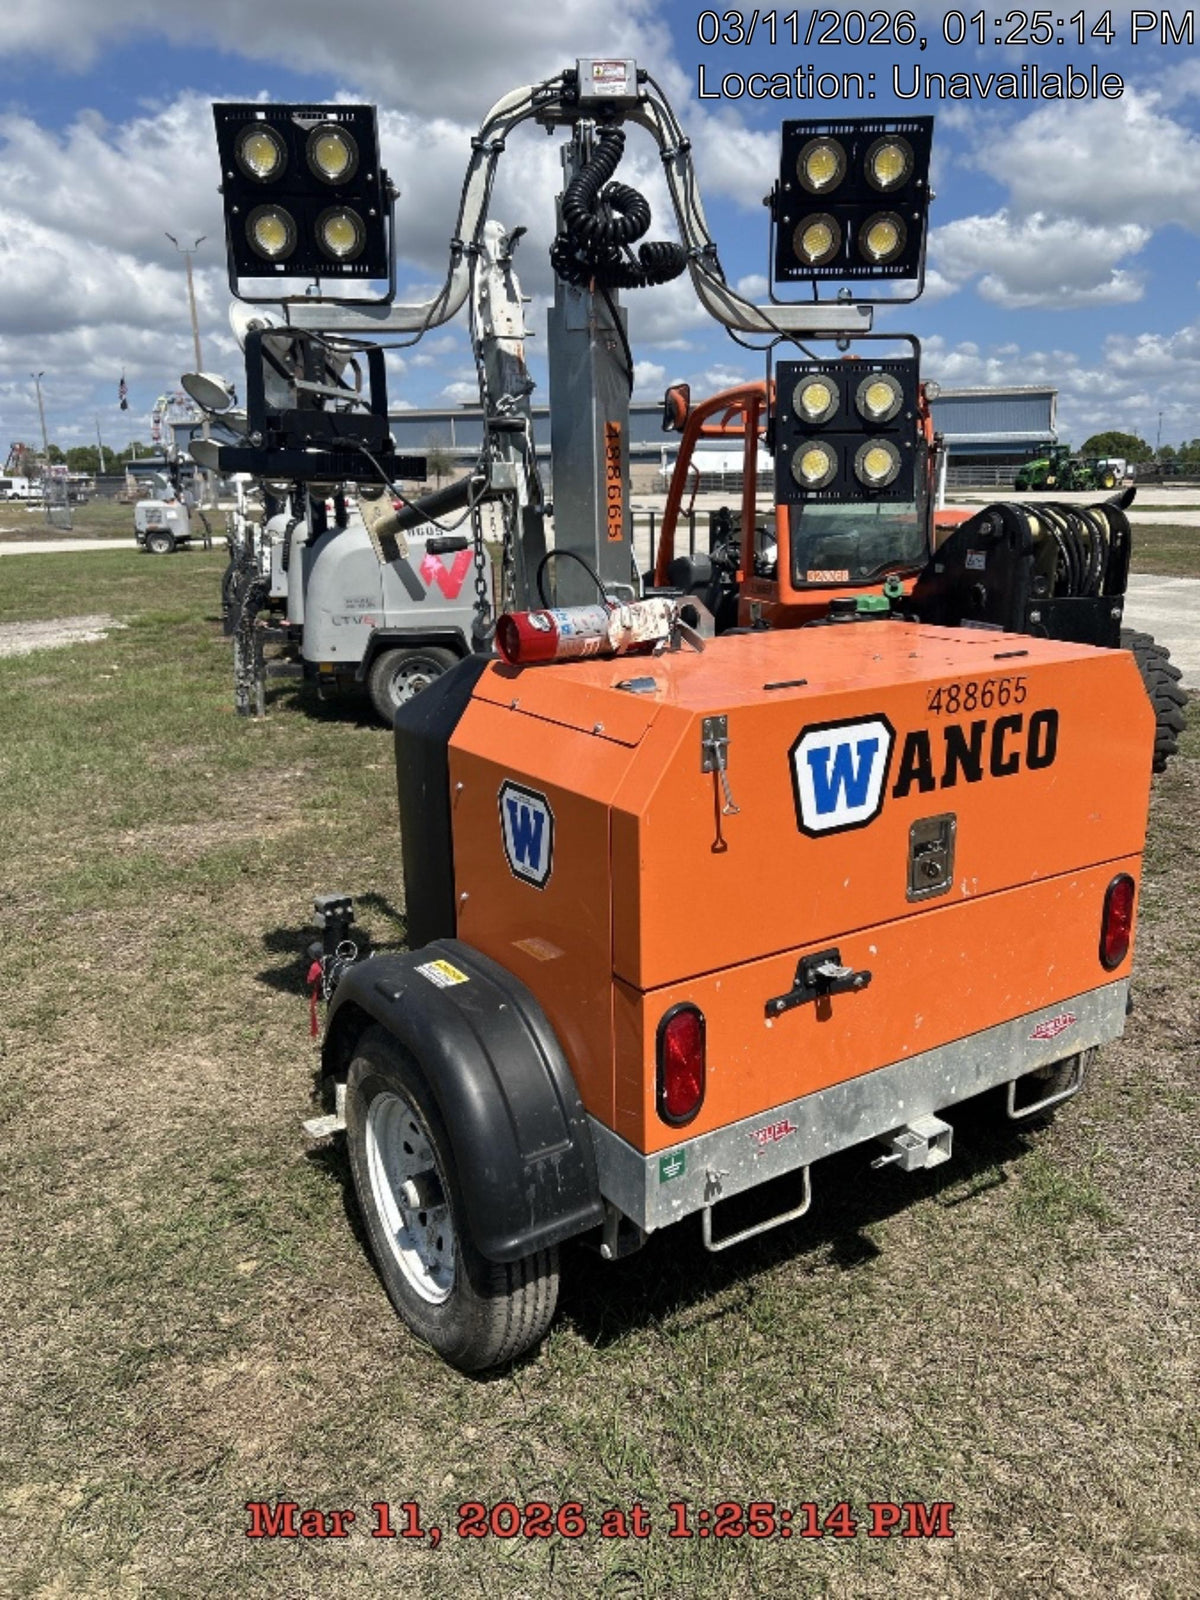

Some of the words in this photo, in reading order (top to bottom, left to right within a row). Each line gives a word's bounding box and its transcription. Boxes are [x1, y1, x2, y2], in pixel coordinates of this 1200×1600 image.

[606, 421, 621, 538] 488665
[927, 676, 1028, 716] 488665
[806, 708, 1059, 816] WANCO
